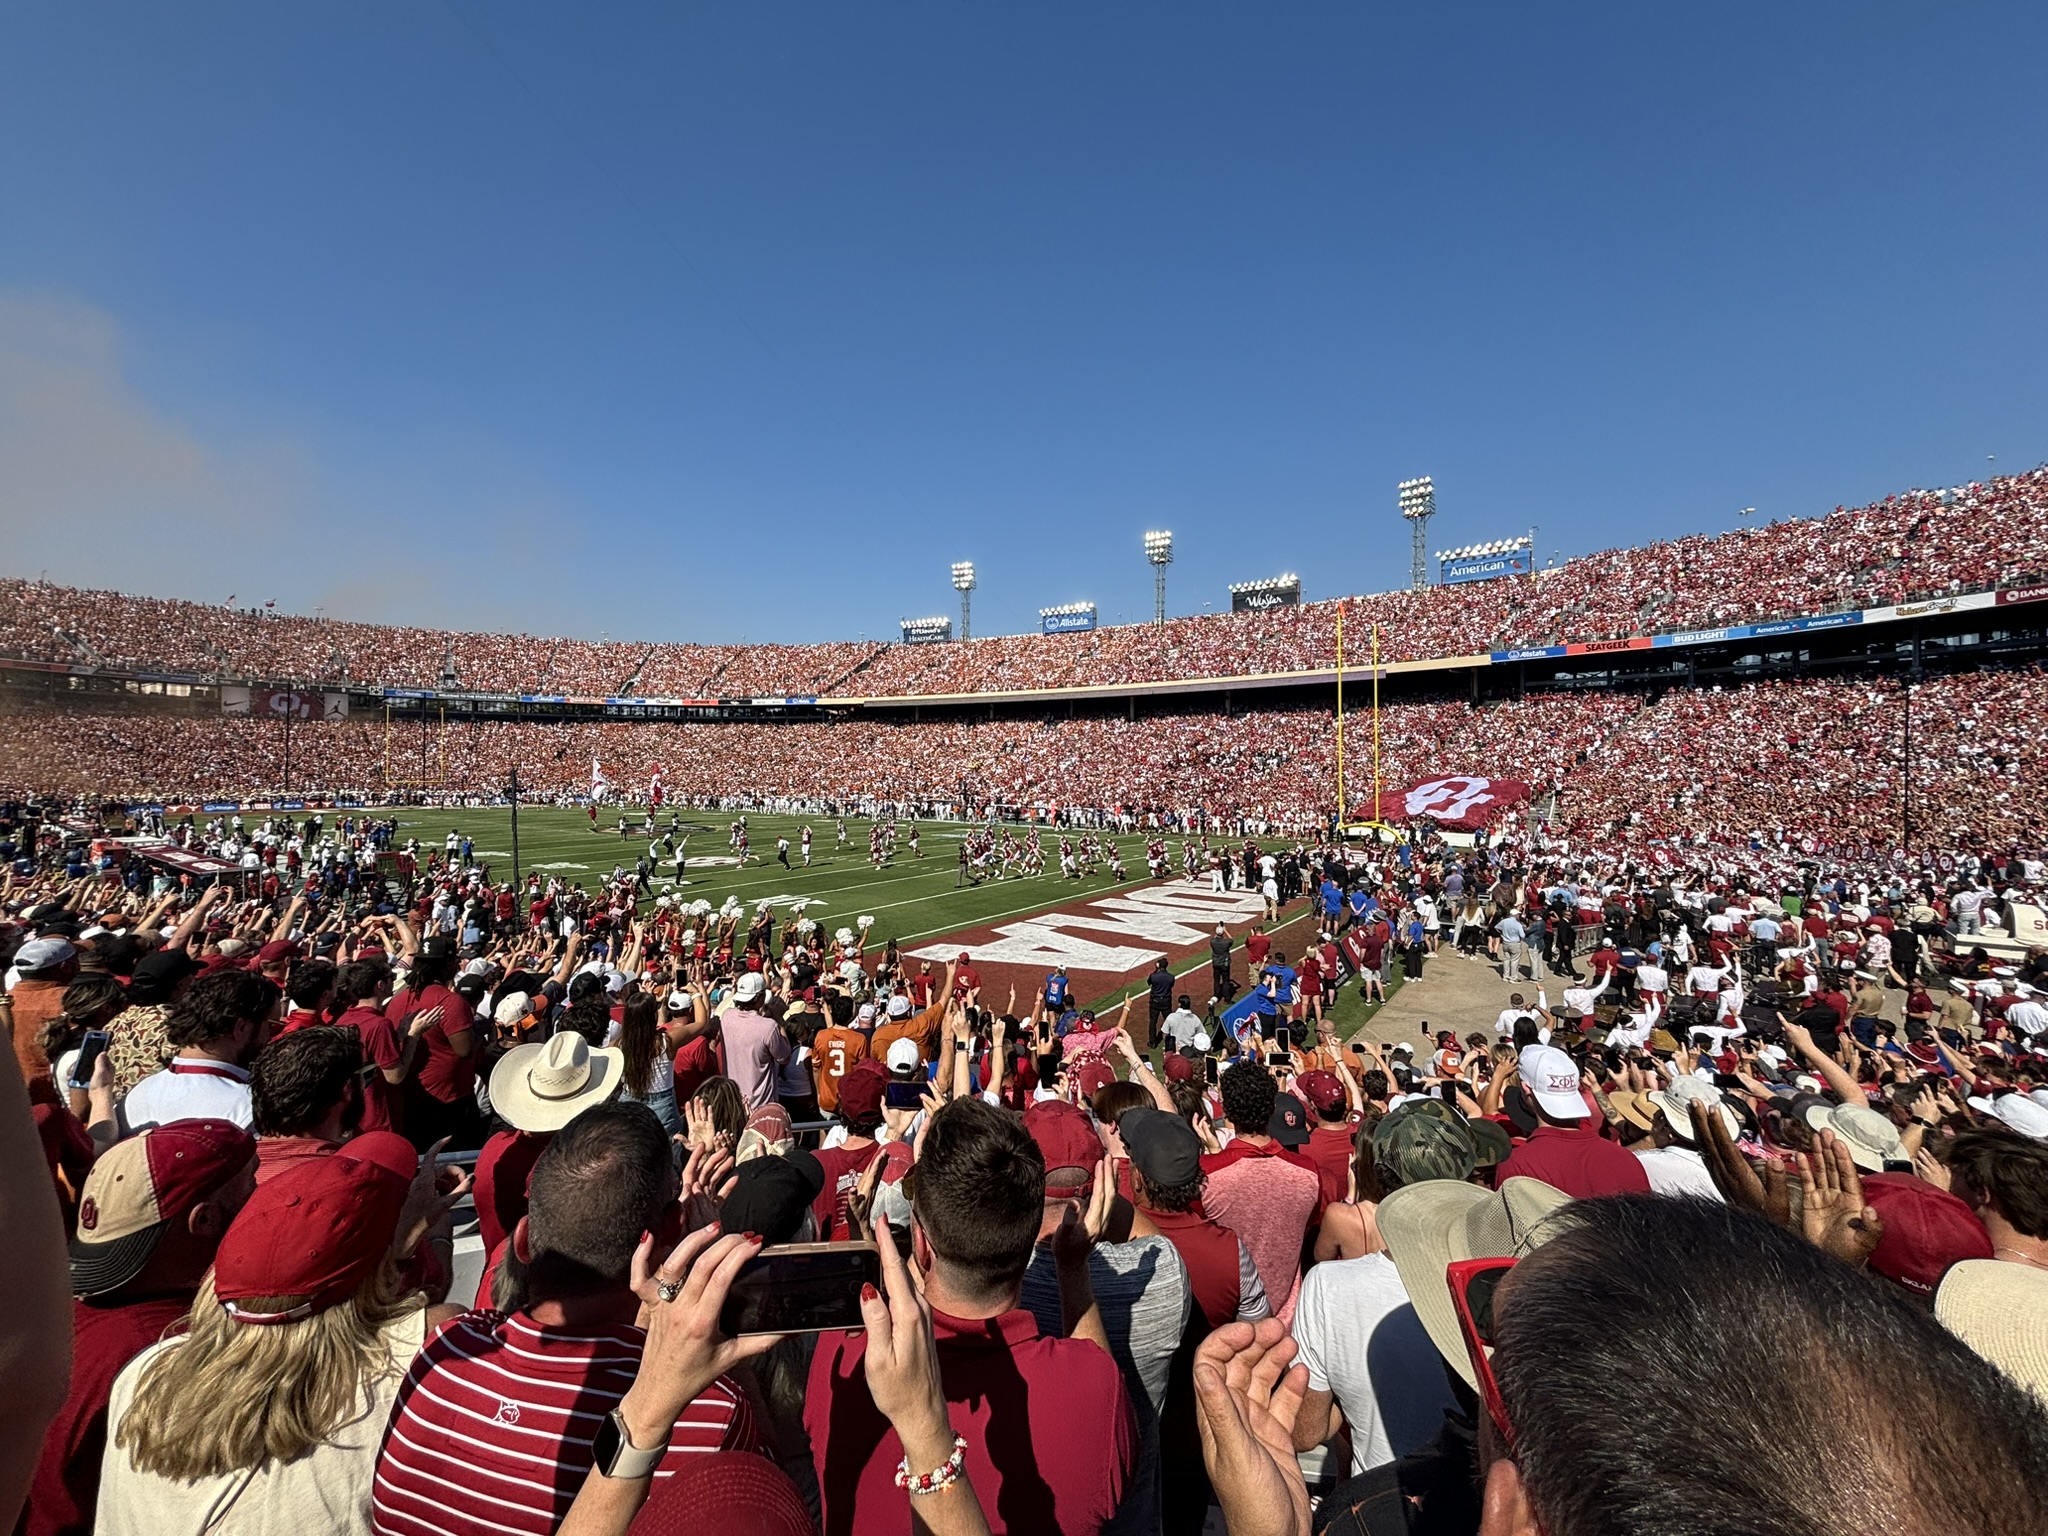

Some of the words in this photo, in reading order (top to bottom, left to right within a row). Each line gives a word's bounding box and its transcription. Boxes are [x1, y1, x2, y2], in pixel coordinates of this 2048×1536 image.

[1450, 559, 1504, 577] American
[1245, 591, 1283, 609] WinStar
[1059, 617, 1089, 627] Allstate
[1755, 624, 1790, 634] American
[1807, 617, 1843, 628] American
[1674, 633, 1695, 643] BUD
[1695, 631, 1725, 641] LIGHT
[1586, 640, 1630, 652] SEATGEEK
[1520, 649, 1547, 658] Allstate
[1801, 839, 1815, 852] OU
[1655, 850, 1668, 864] OU
[1922, 851, 1932, 866] OU
[1939, 856, 1952, 871] OU
[829, 1049, 845, 1077] 3
[1284, 1110, 1297, 1127] OU
[81, 1195, 100, 1231] OU
